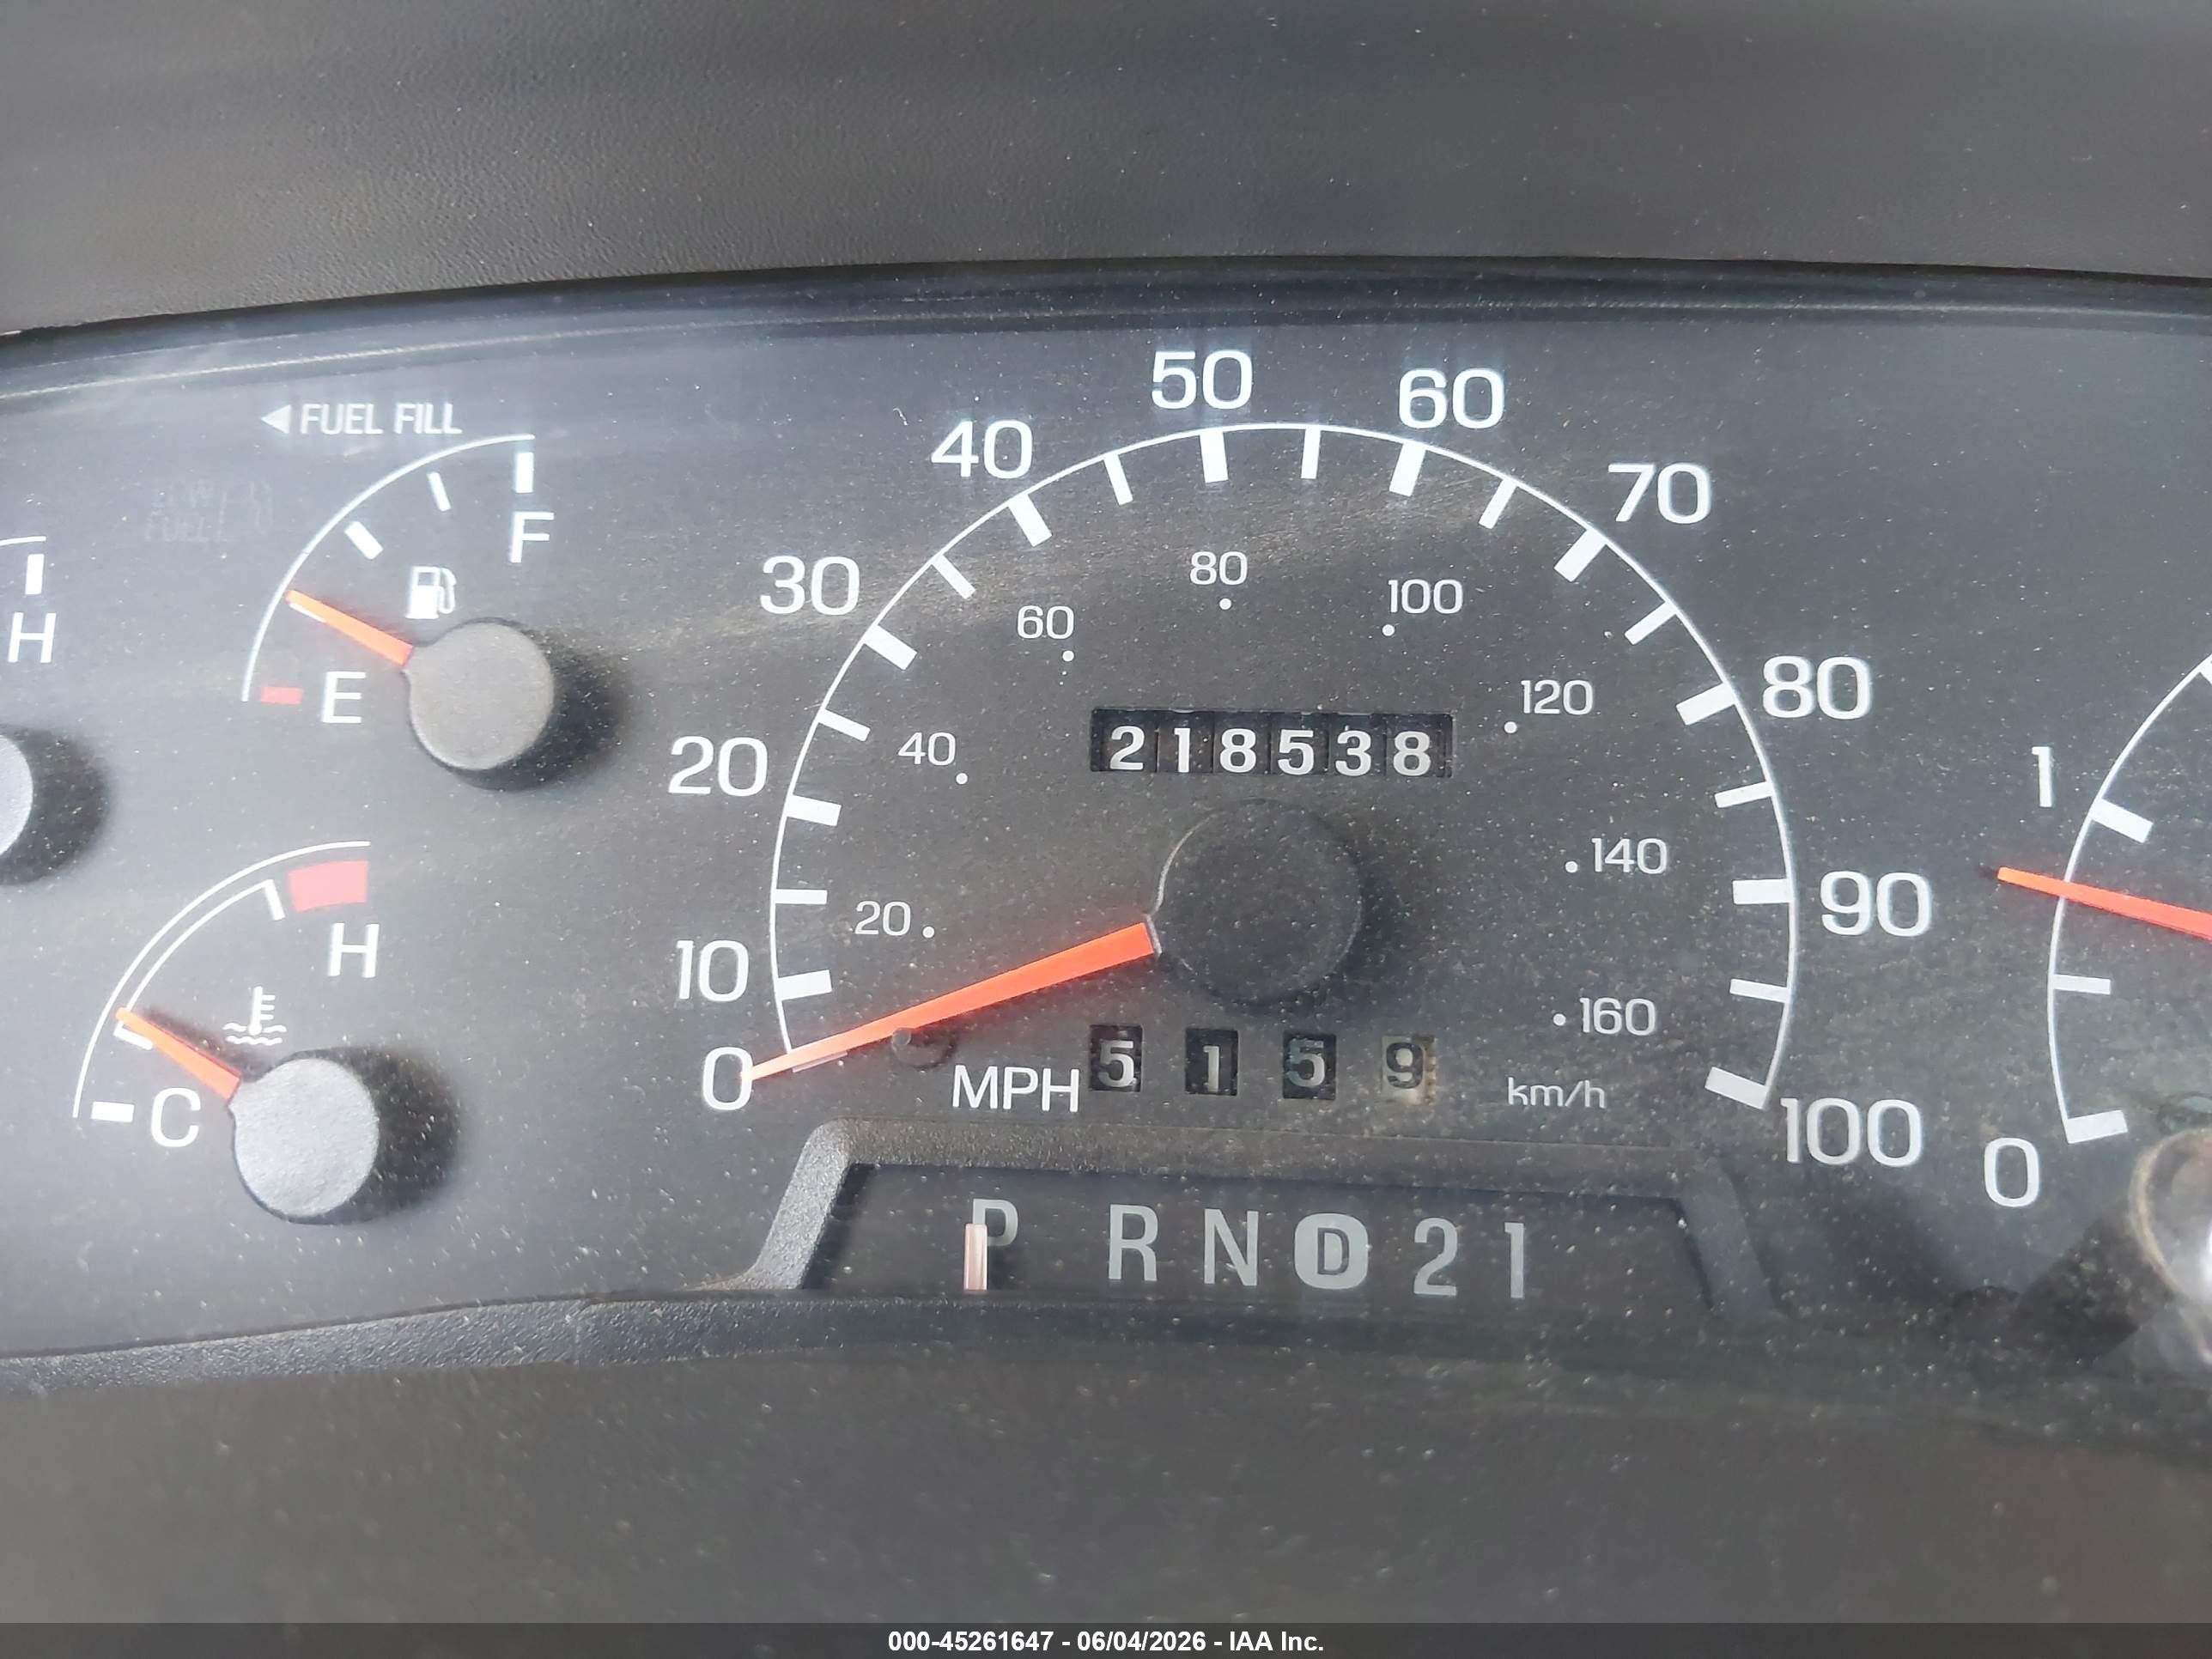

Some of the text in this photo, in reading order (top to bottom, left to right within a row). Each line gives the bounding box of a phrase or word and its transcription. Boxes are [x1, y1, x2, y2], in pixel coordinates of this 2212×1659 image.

[1151, 349, 1254, 410] 50
[1397, 368, 1505, 430] 60
[299, 402, 464, 435] FUEL FILL
[930, 418, 1034, 480] 40
[1607, 461, 1711, 525] 70
[508, 510, 556, 563] F
[759, 554, 861, 617] 30
[1188, 550, 1249, 586] 80
[1386, 578, 1464, 615] 100
[7, 611, 58, 665] H
[1016, 604, 1075, 641] 60
[321, 670, 368, 724] E
[1520, 678, 1595, 716] 120
[1761, 654, 1873, 720] 80
[667, 735, 769, 798] 20
[896, 731, 957, 767] 40
[1109, 725, 1432, 777] 218538
[2030, 745, 2054, 809] 1
[1590, 836, 1668, 875] 140
[854, 900, 912, 937] 20
[1820, 870, 1933, 938] 90
[327, 921, 380, 979] H
[675, 939, 750, 1003] 10
[1578, 996, 1657, 1036] 160
[701, 1045, 753, 1111] 0
[951, 1063, 1080, 1114] MPH
[1507, 1076, 1606, 1109] km/h
[149, 1086, 202, 1149] C
[1779, 1097, 1923, 1168] 100
[1983, 1136, 2041, 1209] 0
[972, 1198, 1019, 1279] P
[1108, 1203, 1159, 1282] R
[1203, 1207, 1260, 1287] N
[1413, 1217, 1459, 1297] 2
[1504, 1221, 1526, 1299] 1
